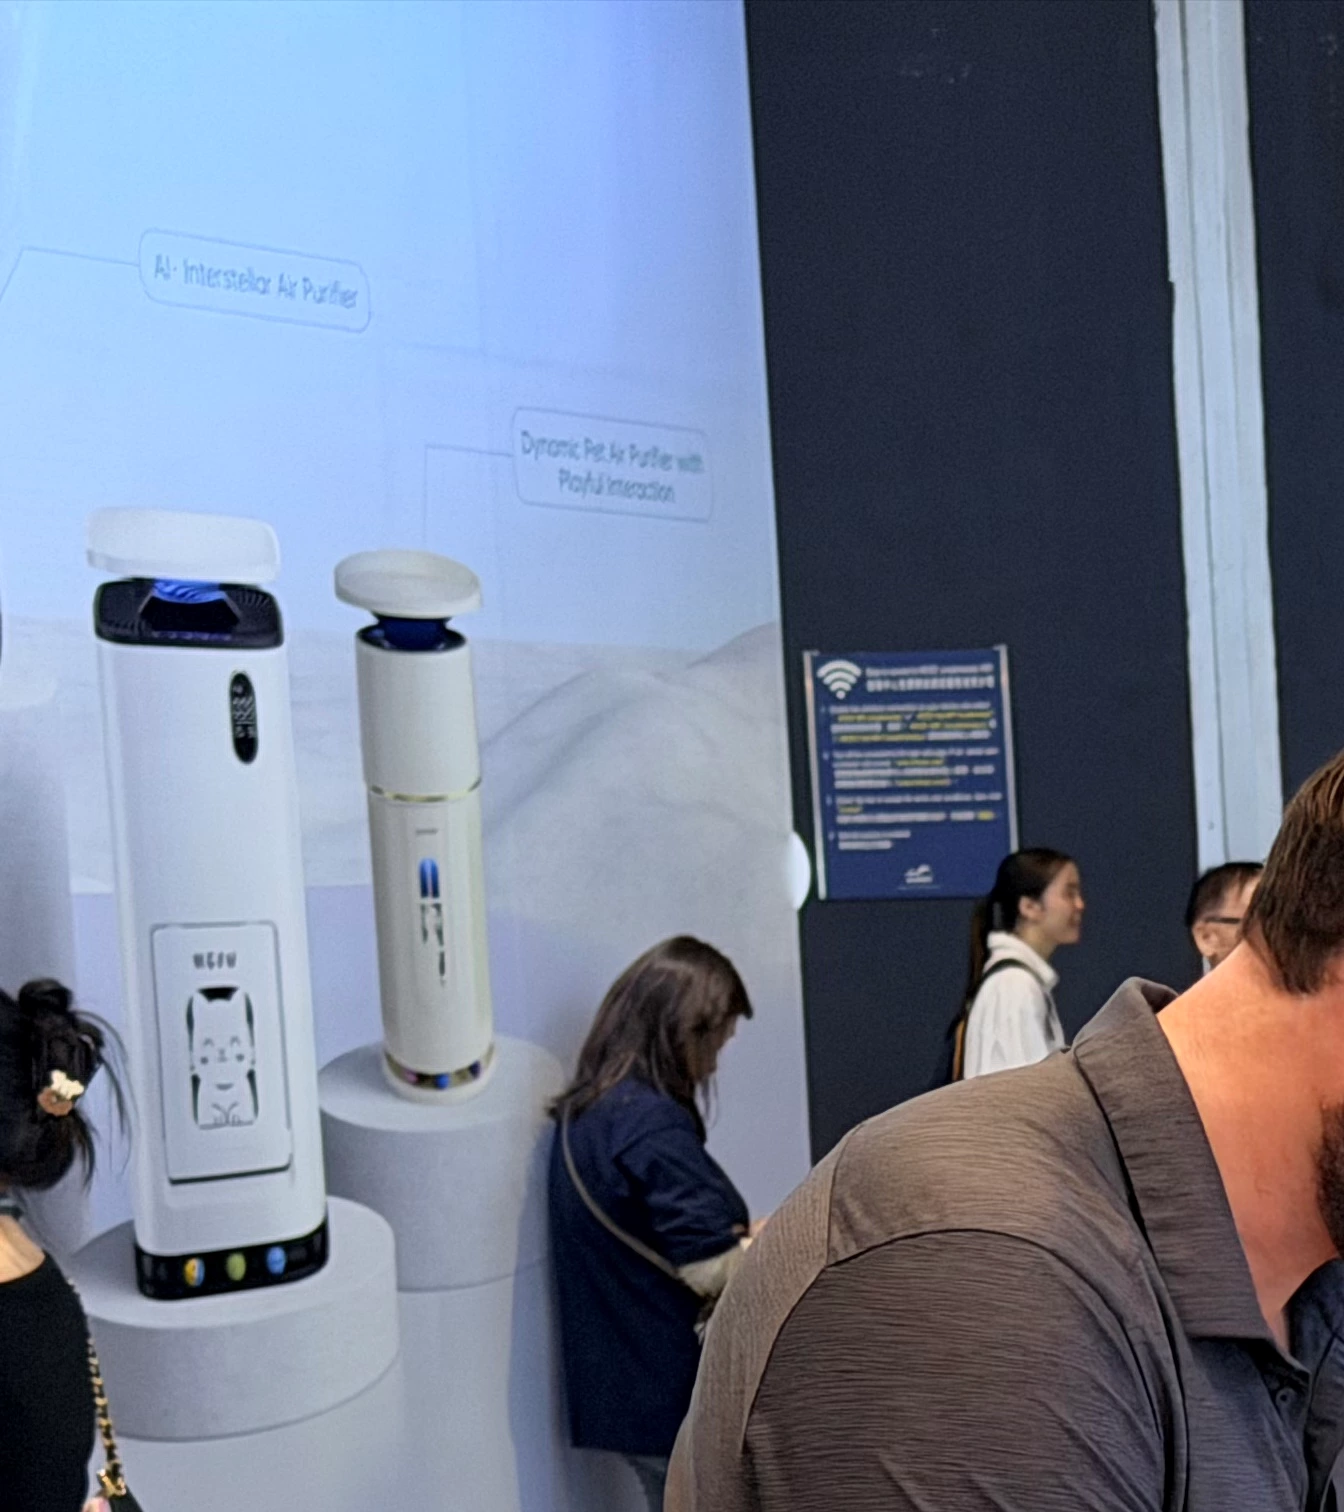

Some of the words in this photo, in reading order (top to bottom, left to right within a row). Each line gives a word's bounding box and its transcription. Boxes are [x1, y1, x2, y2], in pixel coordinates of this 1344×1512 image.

[183, 258, 271, 294] Interstellar
[278, 272, 298, 300] Air
[302, 276, 358, 309] Purifier
[521, 430, 580, 461] Dynamic
[628, 443, 673, 472] Purifier
[558, 467, 604, 500] Playful
[607, 476, 676, 503] Interaction
